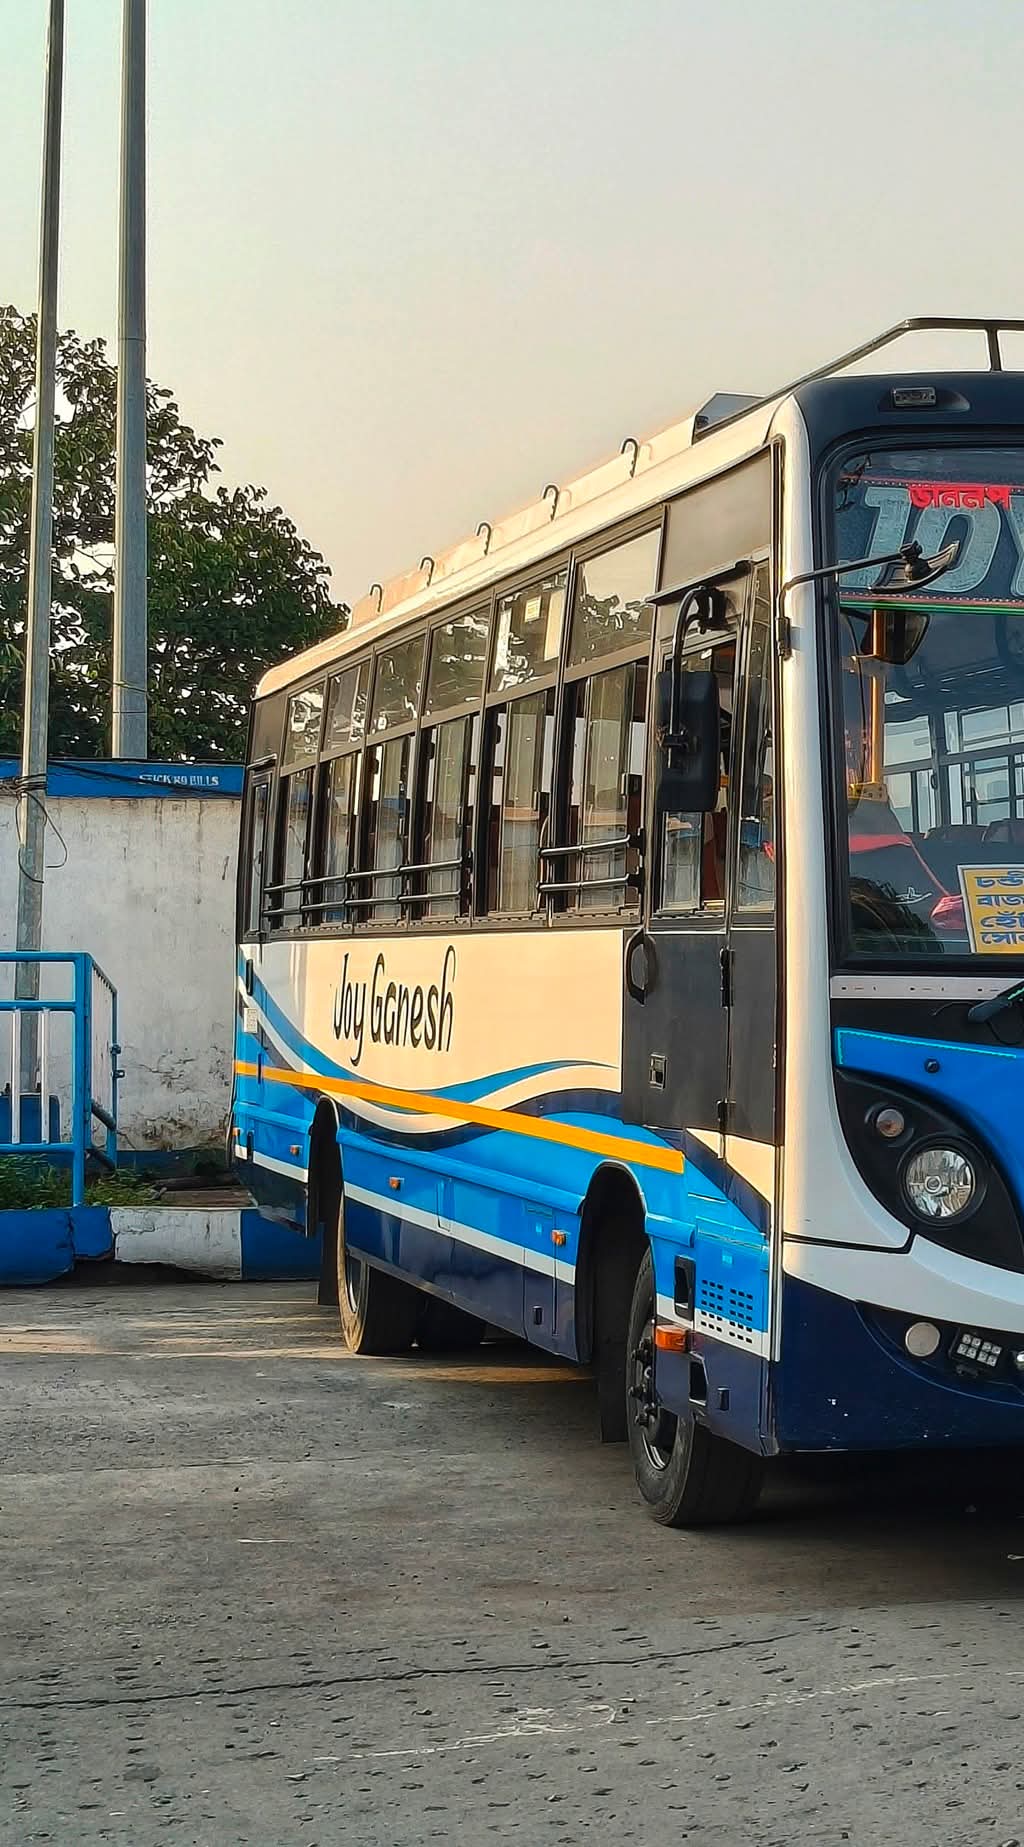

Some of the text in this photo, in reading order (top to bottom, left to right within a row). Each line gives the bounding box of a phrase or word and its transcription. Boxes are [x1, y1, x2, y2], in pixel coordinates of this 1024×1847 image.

[189, 775, 219, 786] BILLS
[333, 945, 457, 1067] Joy Ganesh
